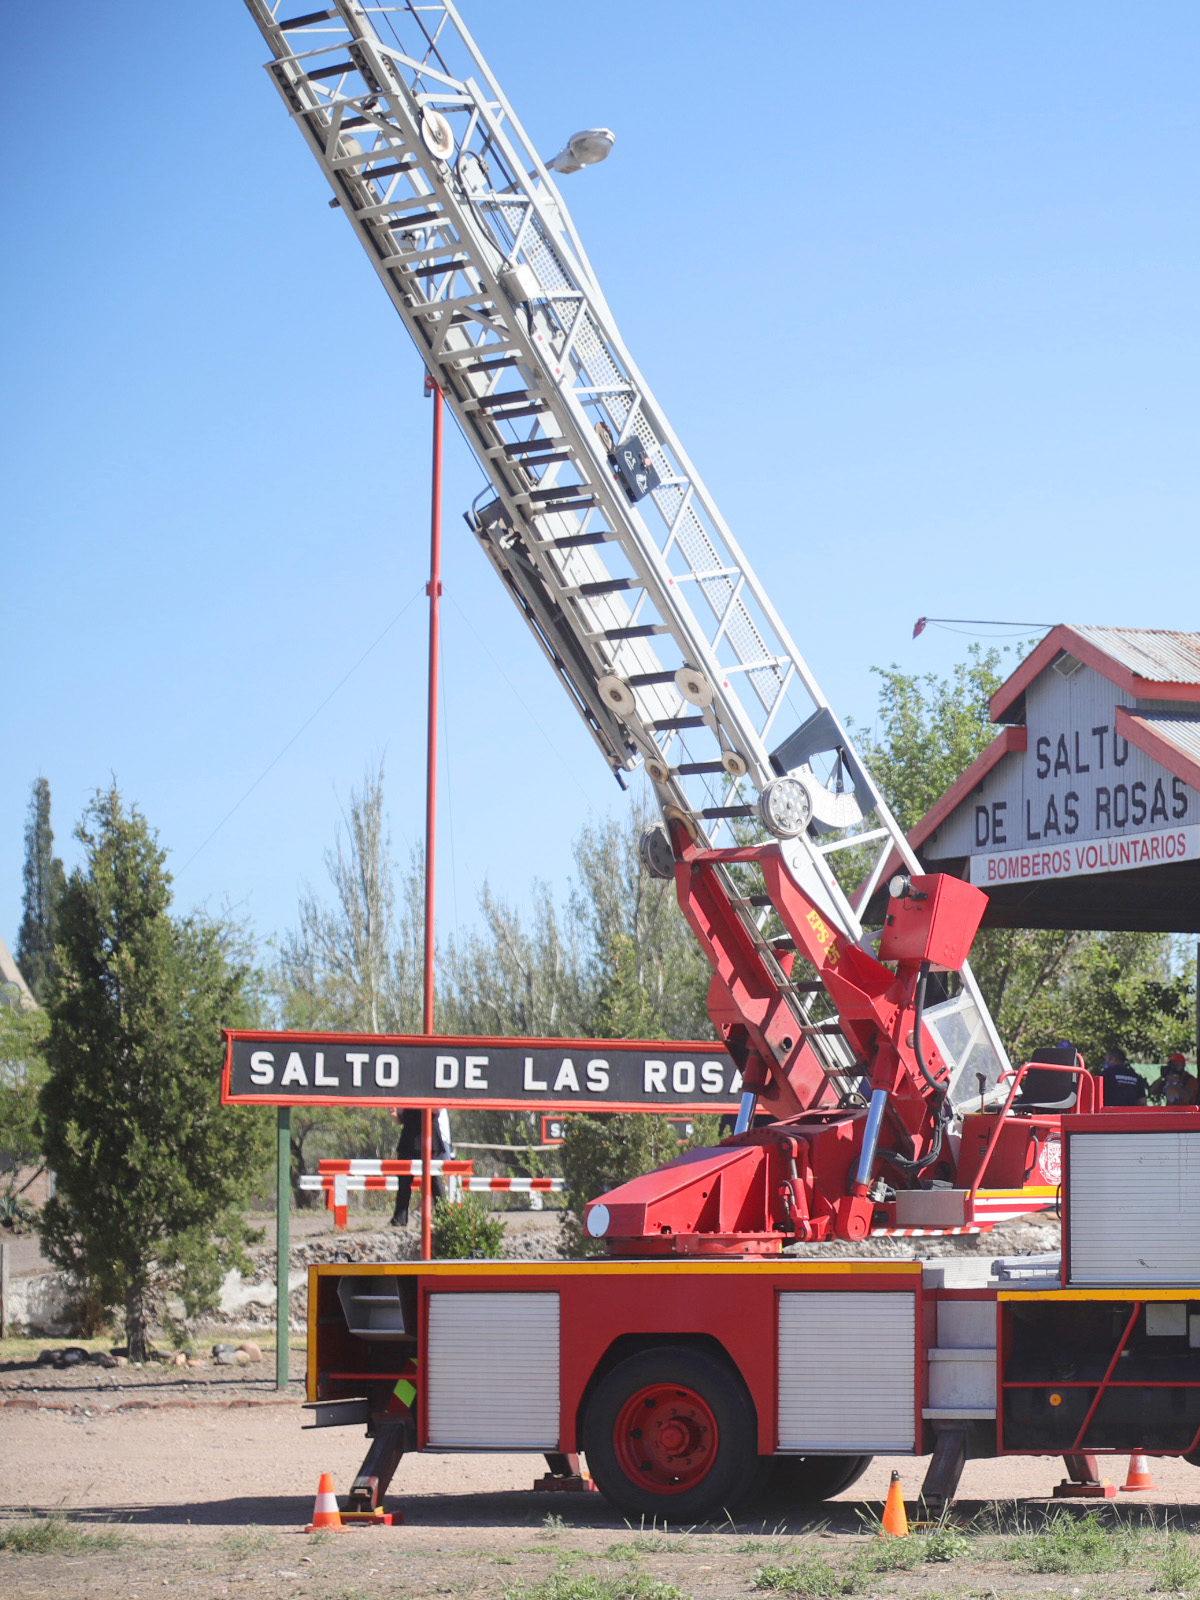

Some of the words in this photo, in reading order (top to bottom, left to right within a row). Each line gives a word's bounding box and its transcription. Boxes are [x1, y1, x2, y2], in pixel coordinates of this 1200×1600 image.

[1037, 725, 1129, 779] SALTO
[975, 801, 1007, 847] DE
[1026, 791, 1080, 841] LAS
[1096, 777, 1188, 831] ROSAS
[988, 849, 1071, 881] BOMBEROS
[1075, 832, 1186, 870] VOLUNTARIOS
[806, 909, 830, 944] EPS
[824, 941, 841, 965] 25
[249, 1050, 401, 1088] SALTO
[434, 1055, 490, 1090] DE
[523, 1056, 611, 1092] LAS
